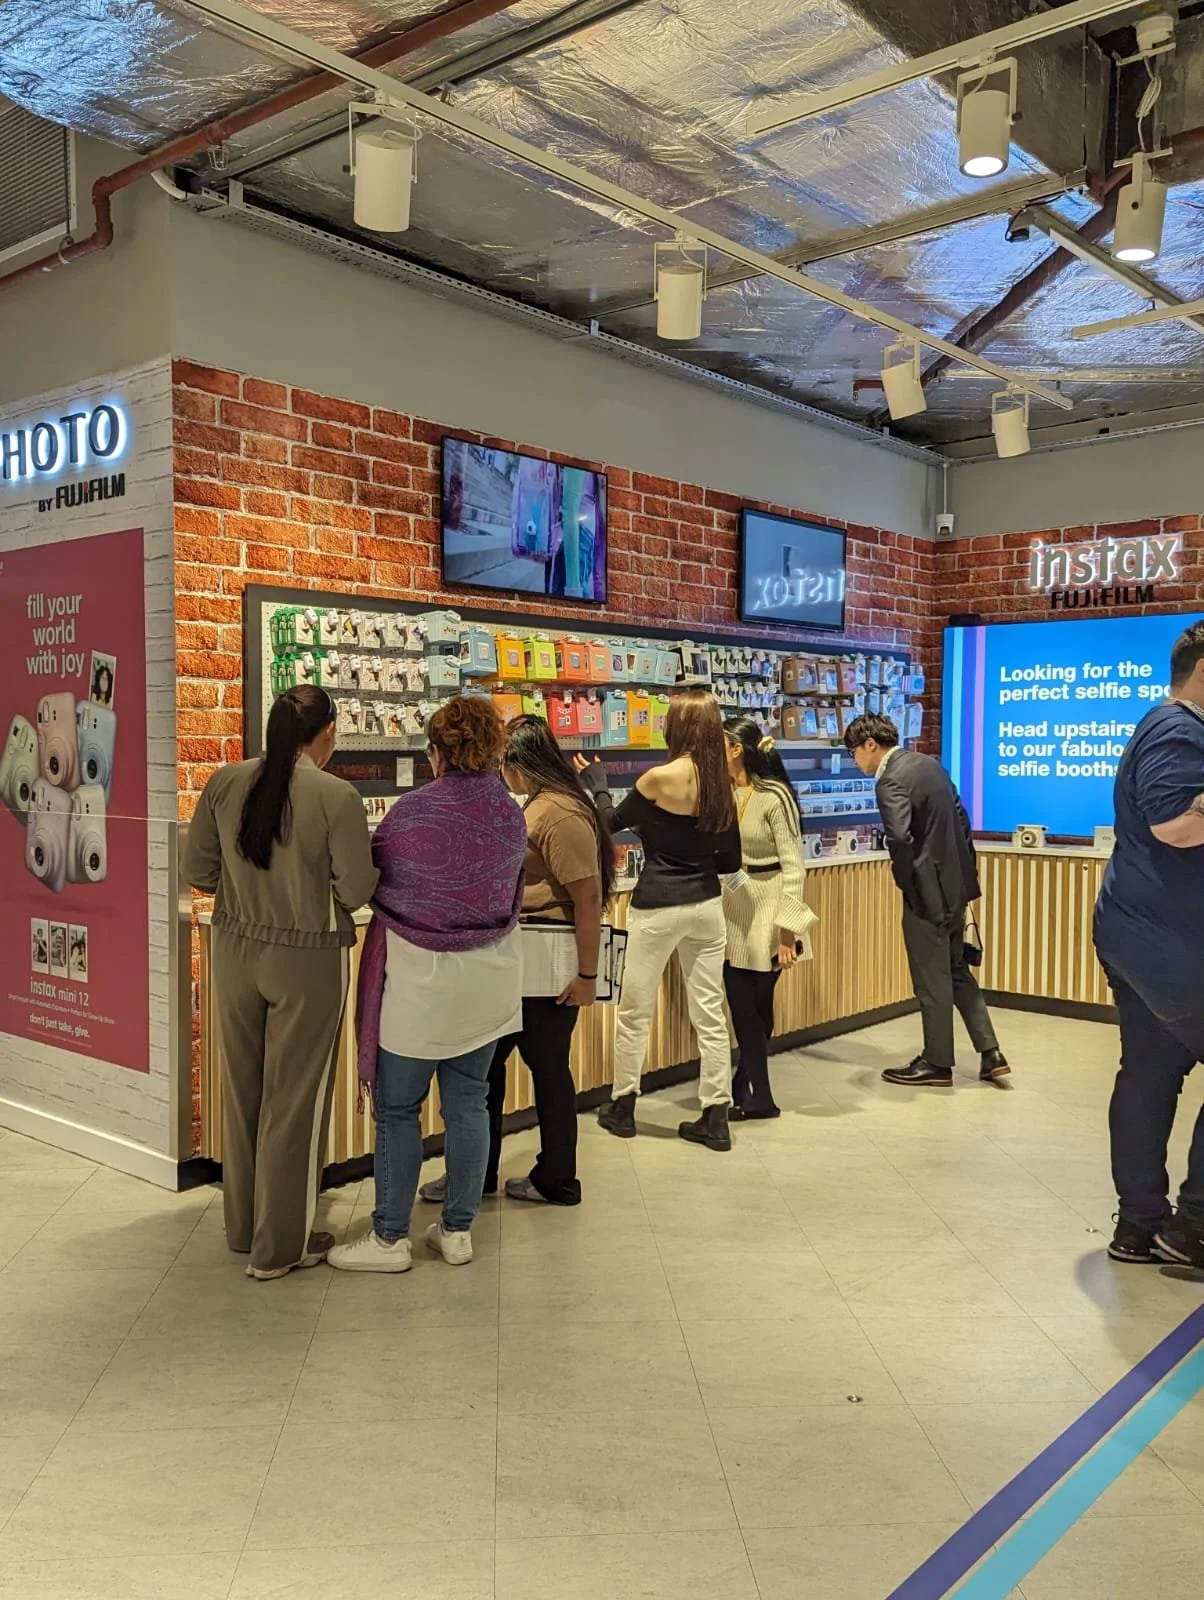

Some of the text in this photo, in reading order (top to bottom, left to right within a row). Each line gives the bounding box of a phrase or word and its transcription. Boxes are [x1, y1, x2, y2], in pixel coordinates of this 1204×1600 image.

[2, 404, 120, 480] HOTO
[38, 473, 126, 513] BY FUJIFILM
[1029, 537, 1179, 588] instax
[26, 593, 83, 622] fill your
[1051, 585, 1155, 609] FUJIFILM
[33, 618, 76, 646] world
[26, 648, 85, 679] with joy
[1000, 660, 1153, 683] Looking for the
[999, 684, 1070, 705] perfect
[1075, 682, 1132, 700] selfie
[998, 719, 1137, 739] Head upstairs
[998, 740, 1125, 757] to our fabulo
[998, 760, 1050, 777] selfie
[30, 976, 89, 1007] instax mini 12
[29, 1013, 45, 1026] don't
[45, 1017, 57, 1029] just
[58, 1021, 74, 1035] take,
[75, 1025, 91, 1038] give.
